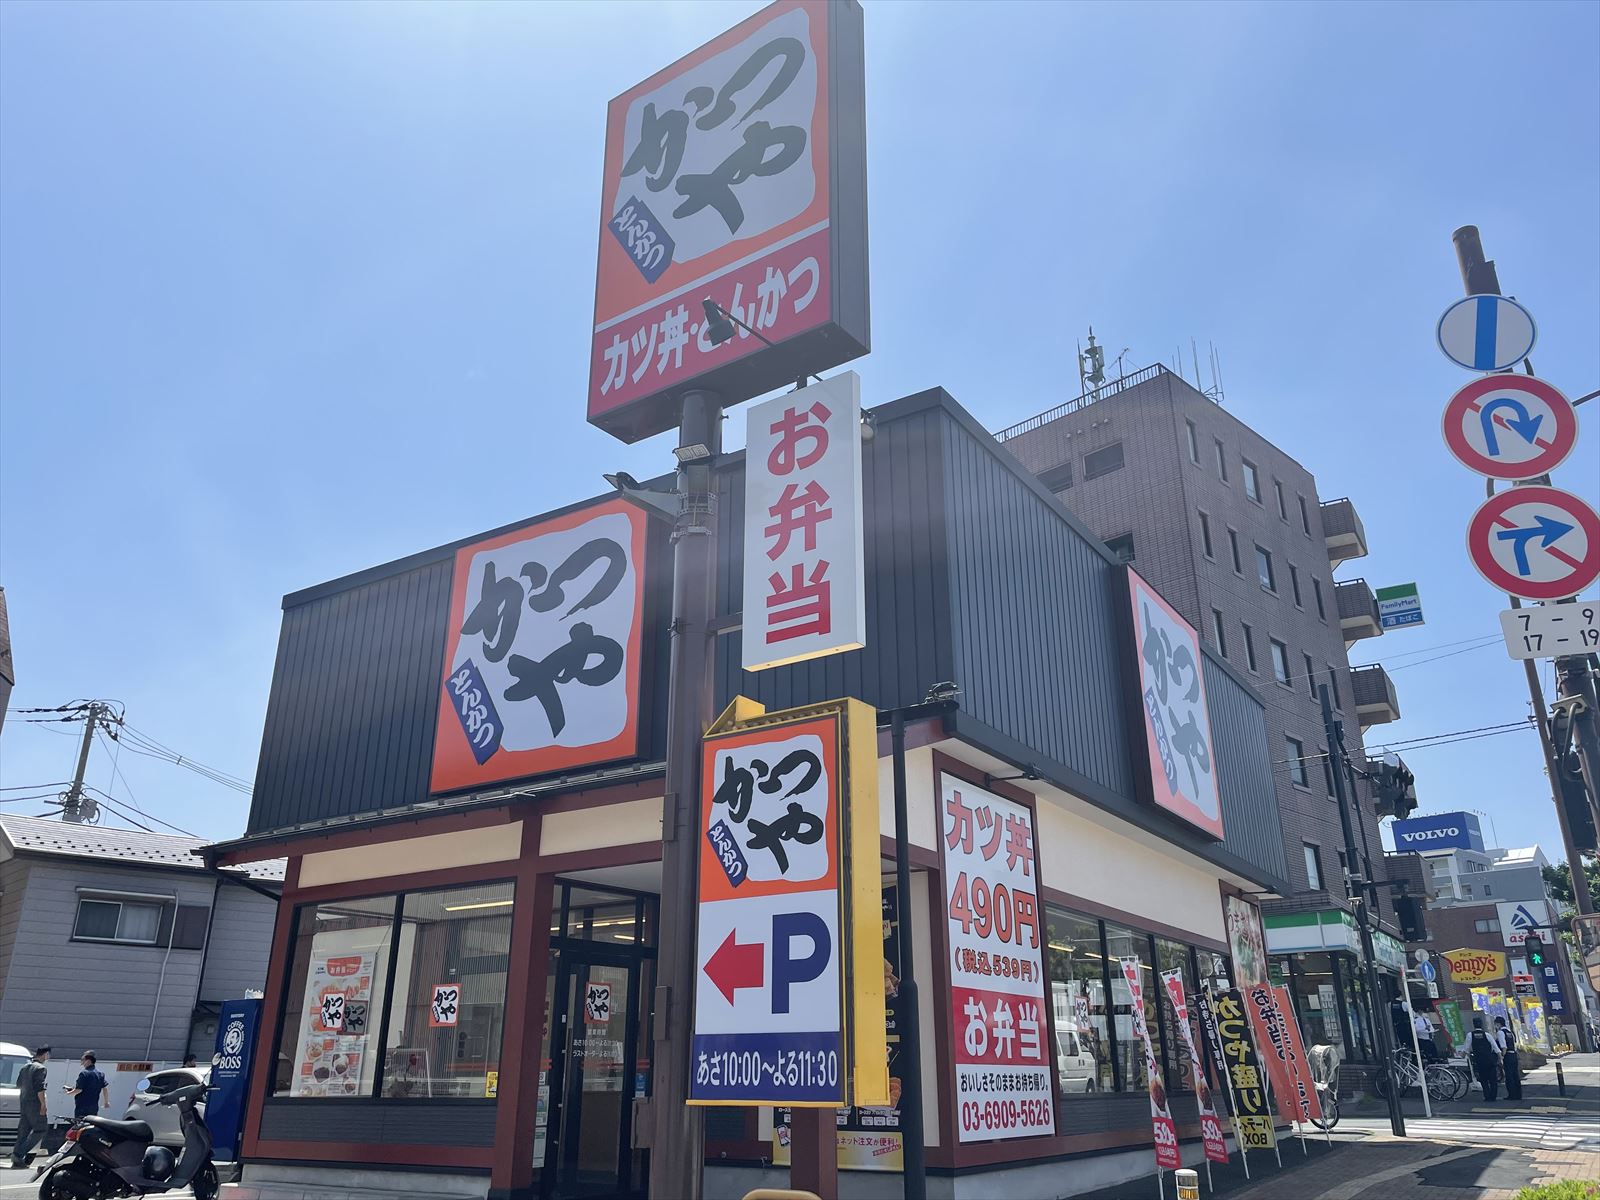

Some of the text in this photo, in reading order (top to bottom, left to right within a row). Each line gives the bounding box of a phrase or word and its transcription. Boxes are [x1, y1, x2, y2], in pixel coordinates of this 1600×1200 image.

[620, 37, 807, 235] かつや
[613, 205, 665, 270] とんかつ
[764, 401, 833, 645] お弁当
[1381, 599, 1417, 609] FamilyMart
[1518, 614, 1530, 631] 7
[1582, 608, 1594, 625] 9
[460, 537, 627, 739] かつや
[1523, 634, 1543, 652] 17
[1580, 628, 1600, 647] 19
[451, 669, 495, 748] とんかつ
[712, 749, 824, 875] かつや
[945, 790, 1034, 876] カツ丼
[1401, 827, 1460, 842] VOLVO
[710, 825, 742, 878] とんかつ
[950, 871, 1040, 950] 490円
[771, 912, 832, 1014] P
[227, 1020, 244, 1032] COFFEE
[963, 996, 1041, 1060] お弁当
[219, 1056, 242, 1069] BOSS
[960, 1072, 1049, 1093] おいしさそのままお持ち帰り。
[962, 1099, 1050, 1131] 03-6909-5626
